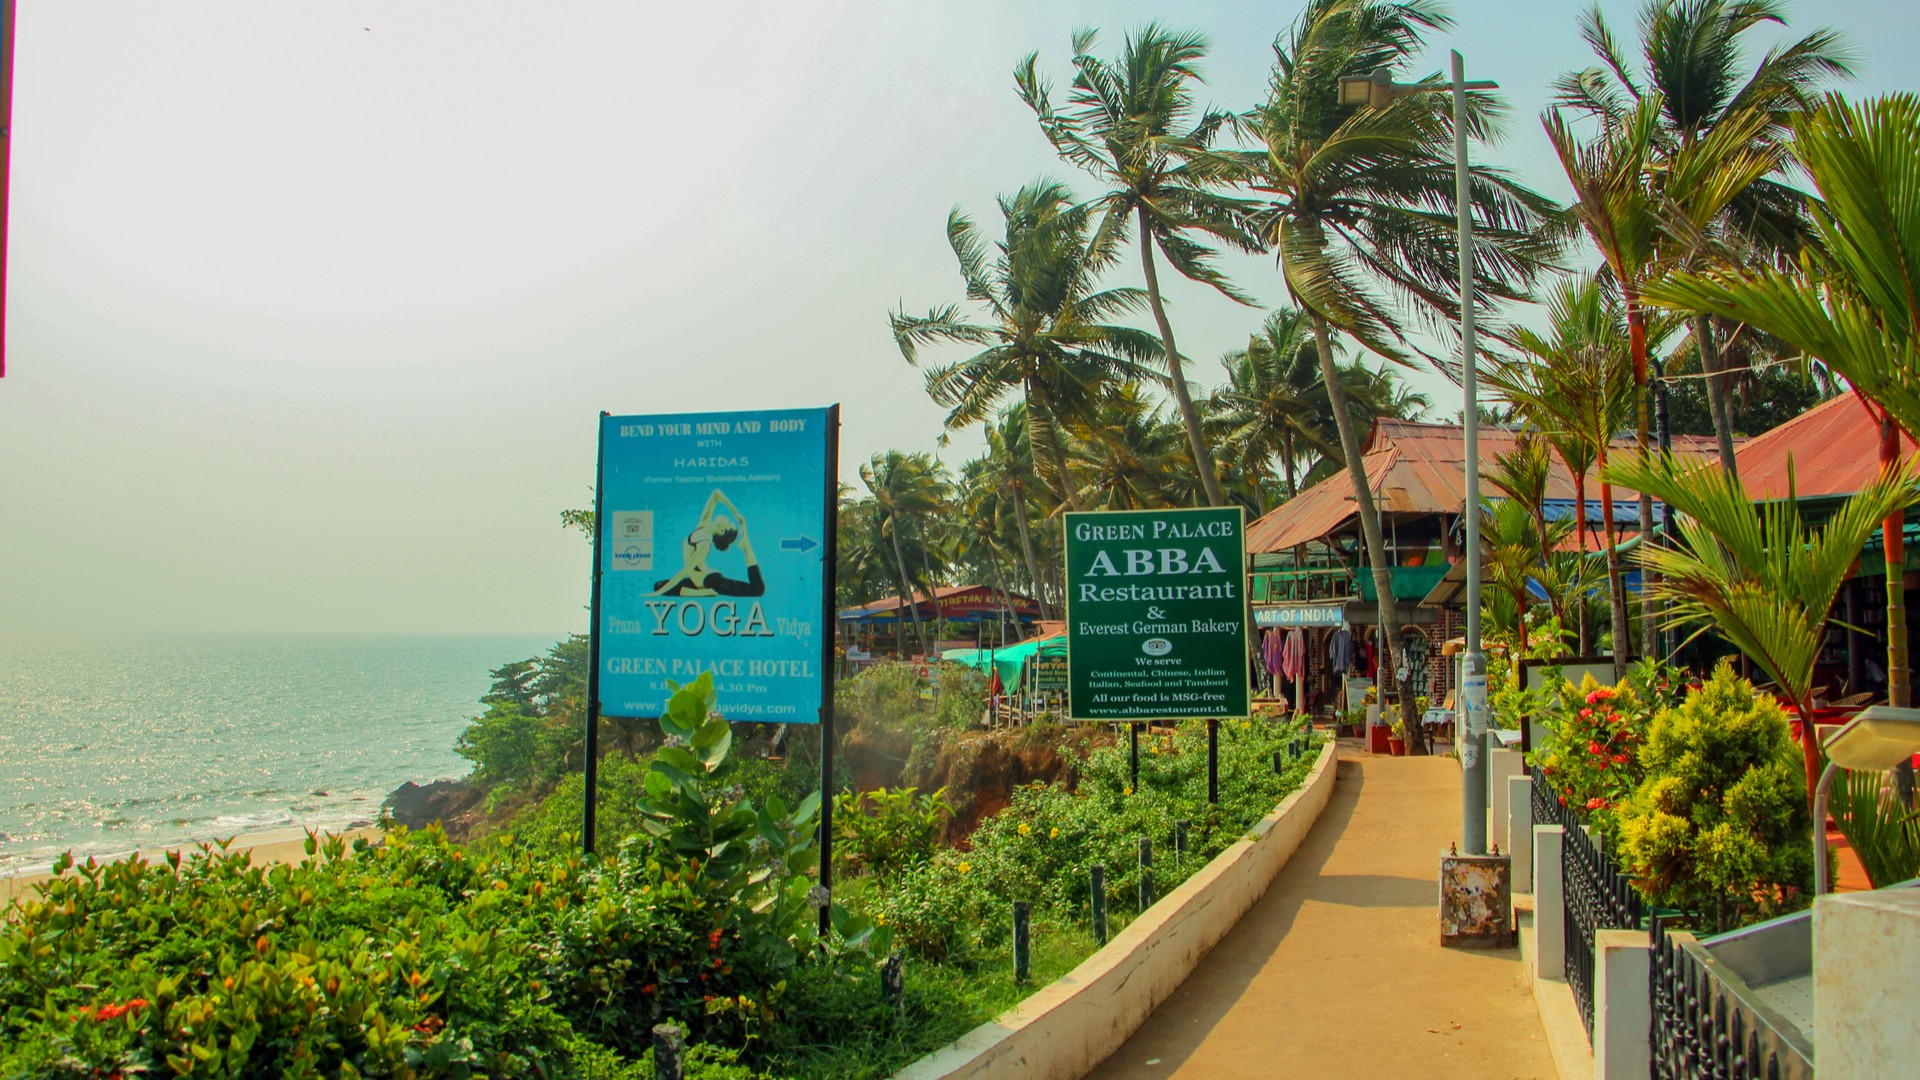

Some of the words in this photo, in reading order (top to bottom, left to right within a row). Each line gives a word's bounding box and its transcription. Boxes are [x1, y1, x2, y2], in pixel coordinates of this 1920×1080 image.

[620, 425, 654, 438] BEND
[658, 423, 692, 436] YOUR
[695, 422, 730, 435] MIND
[733, 421, 761, 434] AND
[769, 419, 807, 433] BODY
[697, 439, 722, 448] WITH
[674, 456, 749, 468] HARIDAS
[675, 475, 705, 483] Teacher
[1084, 546, 1226, 577] ABBA
[1078, 581, 1235, 602] Restaurant
[938, 595, 983, 608] TIBETAN
[1146, 606, 1166, 620] &
[1257, 610, 1277, 622] ART
[1281, 610, 1296, 622] OF
[1300, 609, 1336, 622] INDIA
[608, 616, 641, 634] Prana
[645, 600, 775, 637] YOGA
[776, 617, 811, 640] Vidya
[1079, 621, 1129, 635] Everest
[1132, 620, 1188, 634] German
[1192, 618, 1240, 635] Bakery
[607, 657, 667, 674] GREEN
[672, 659, 744, 676] PALACE
[749, 660, 814, 678] HOTEL
[1135, 657, 1153, 666] We
[1154, 657, 1182, 666] serve
[1090, 670, 1149, 679] Continental,
[1150, 669, 1192, 678] Chinese,
[1194, 668, 1226, 677] Indian
[717, 682, 743, 693] 4.30
[747, 683, 767, 694] Pm
[1088, 680, 1122, 689] Italian,
[1124, 680, 1162, 688] Seafood
[1164, 679, 1182, 688] and
[1184, 678, 1229, 686] Tandoori
[1092, 694, 1109, 703] All
[1110, 695, 1131, 703] our
[1132, 693, 1158, 702] food
[1160, 692, 1170, 702] is
[1172, 692, 1226, 702] MSG-free
[1089, 705, 1228, 715] www.abbarestaurant.tk
